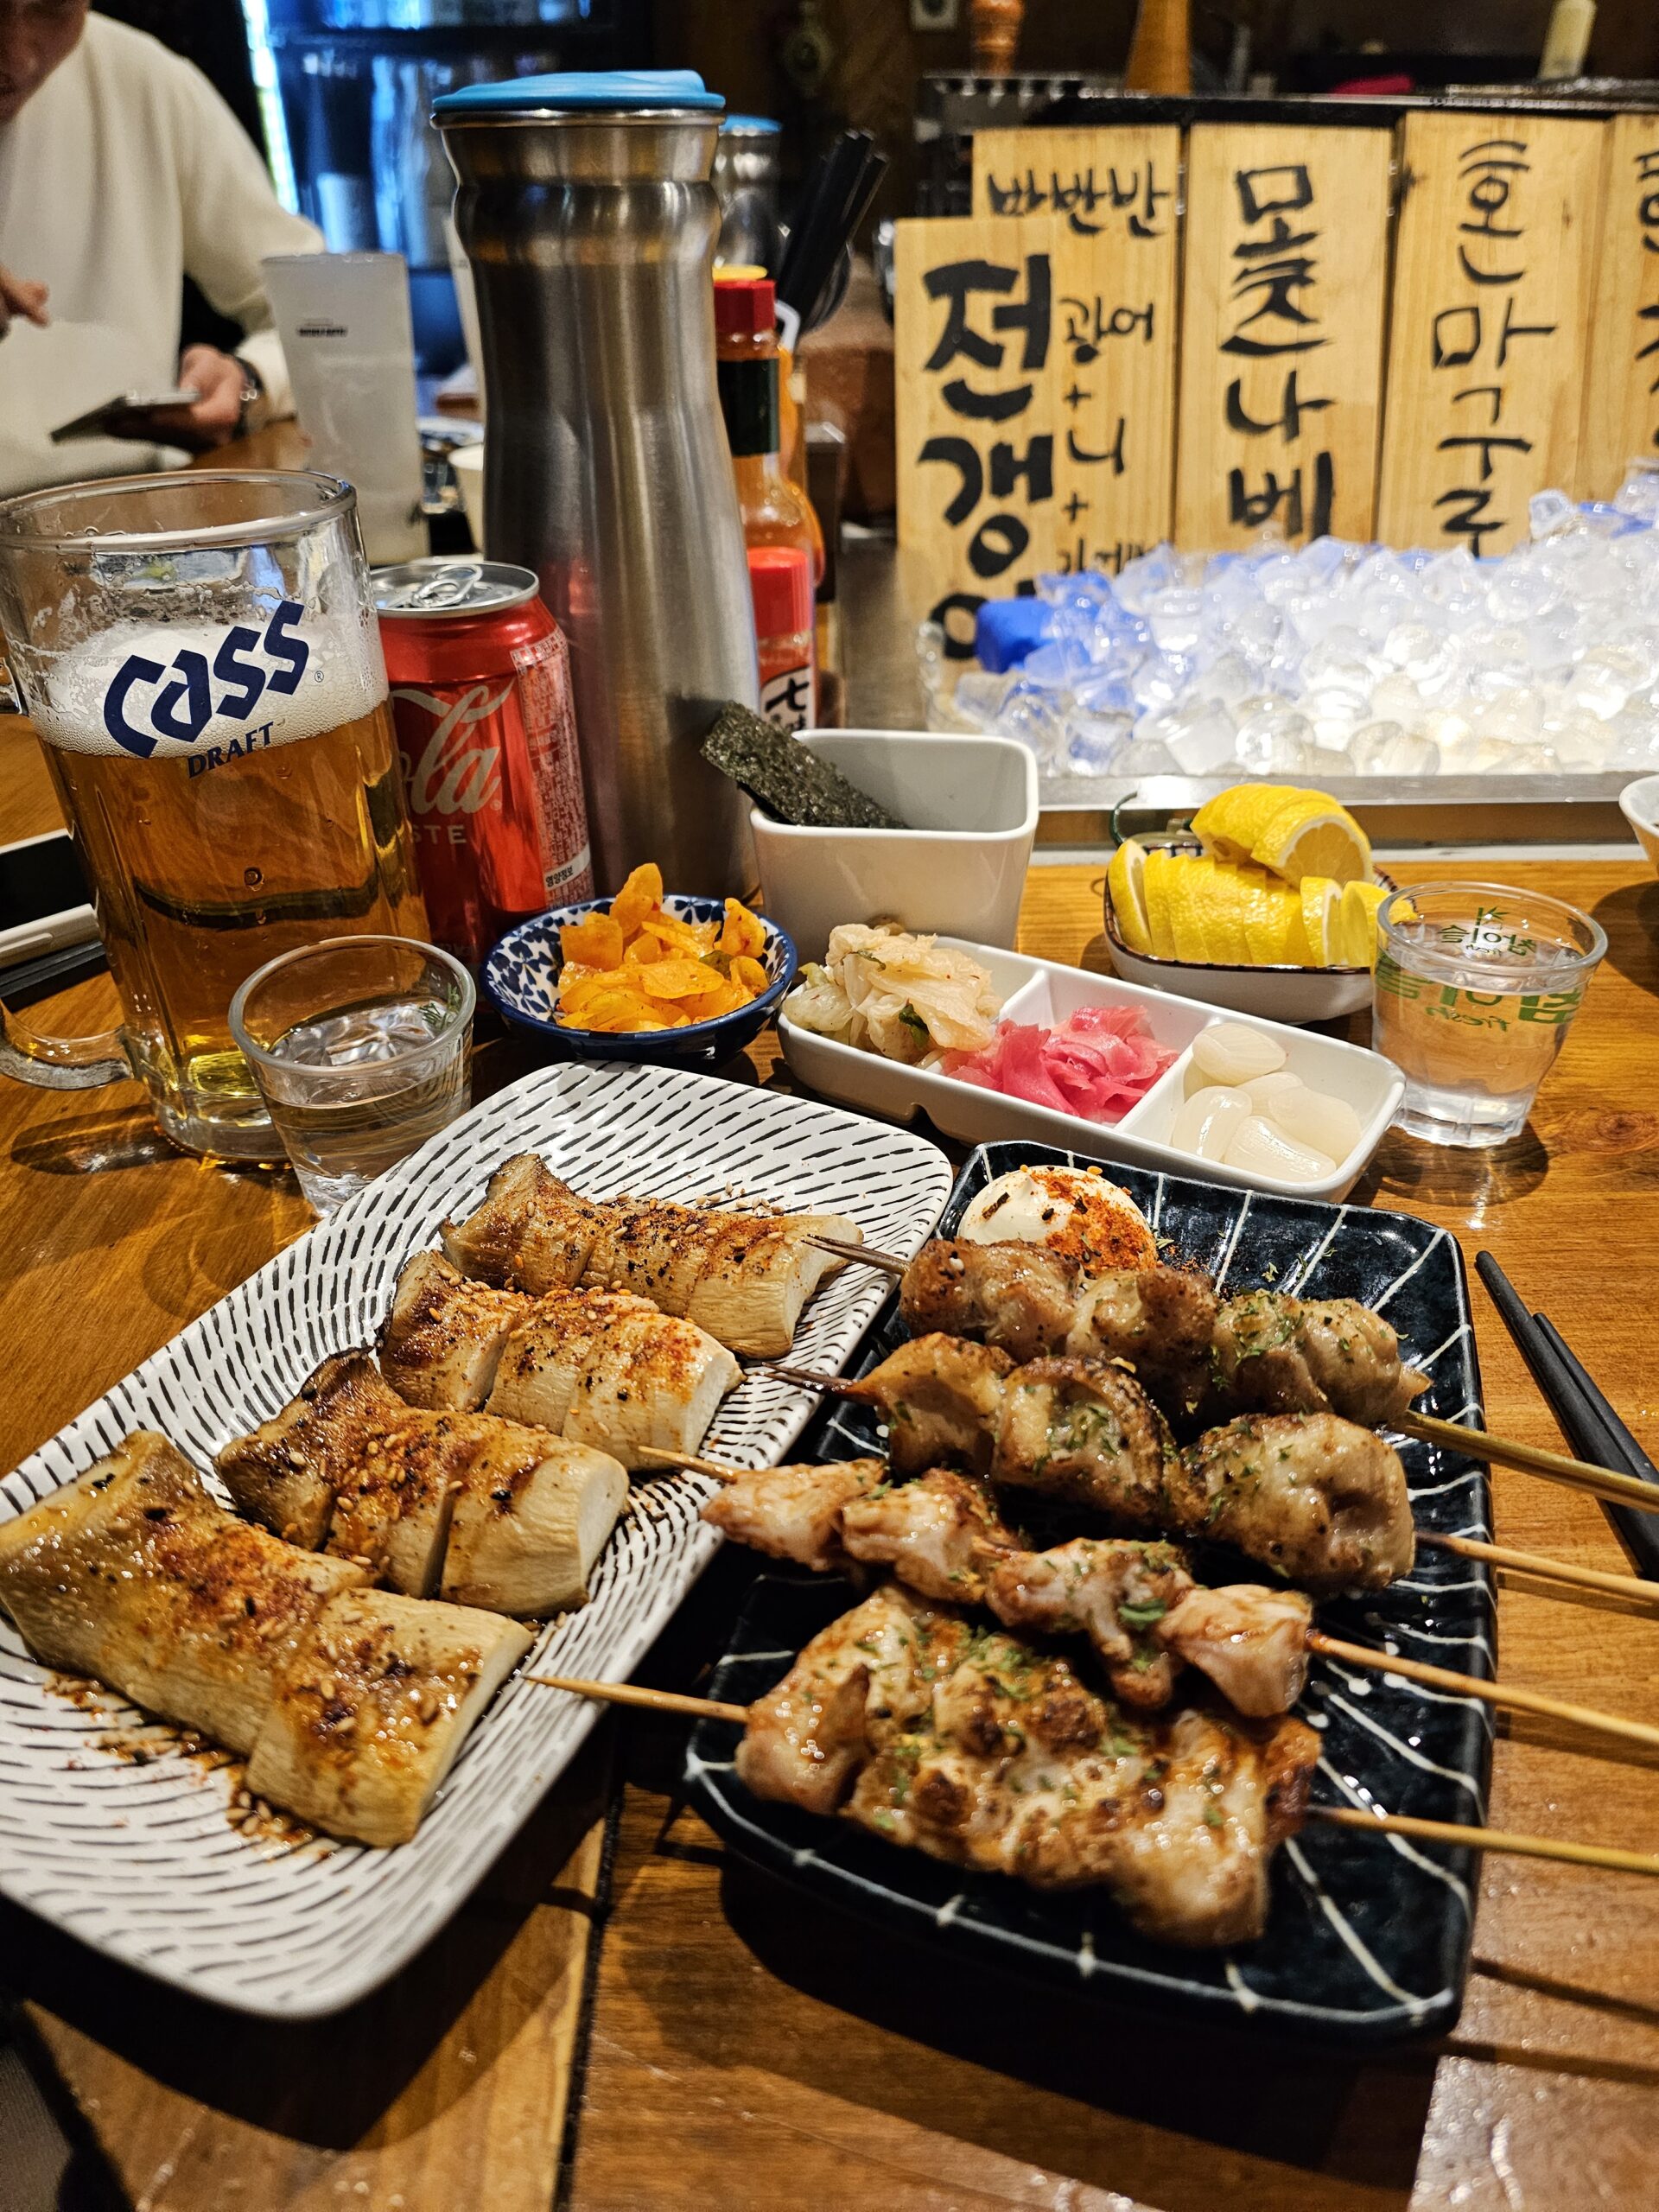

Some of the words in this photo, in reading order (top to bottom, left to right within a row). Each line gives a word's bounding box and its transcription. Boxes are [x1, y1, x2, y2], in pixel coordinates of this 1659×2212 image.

[1218, 162, 1336, 541] 모츠나베
[187, 721, 275, 779] DRAFT
[544, 865, 574, 887] 영양정보
